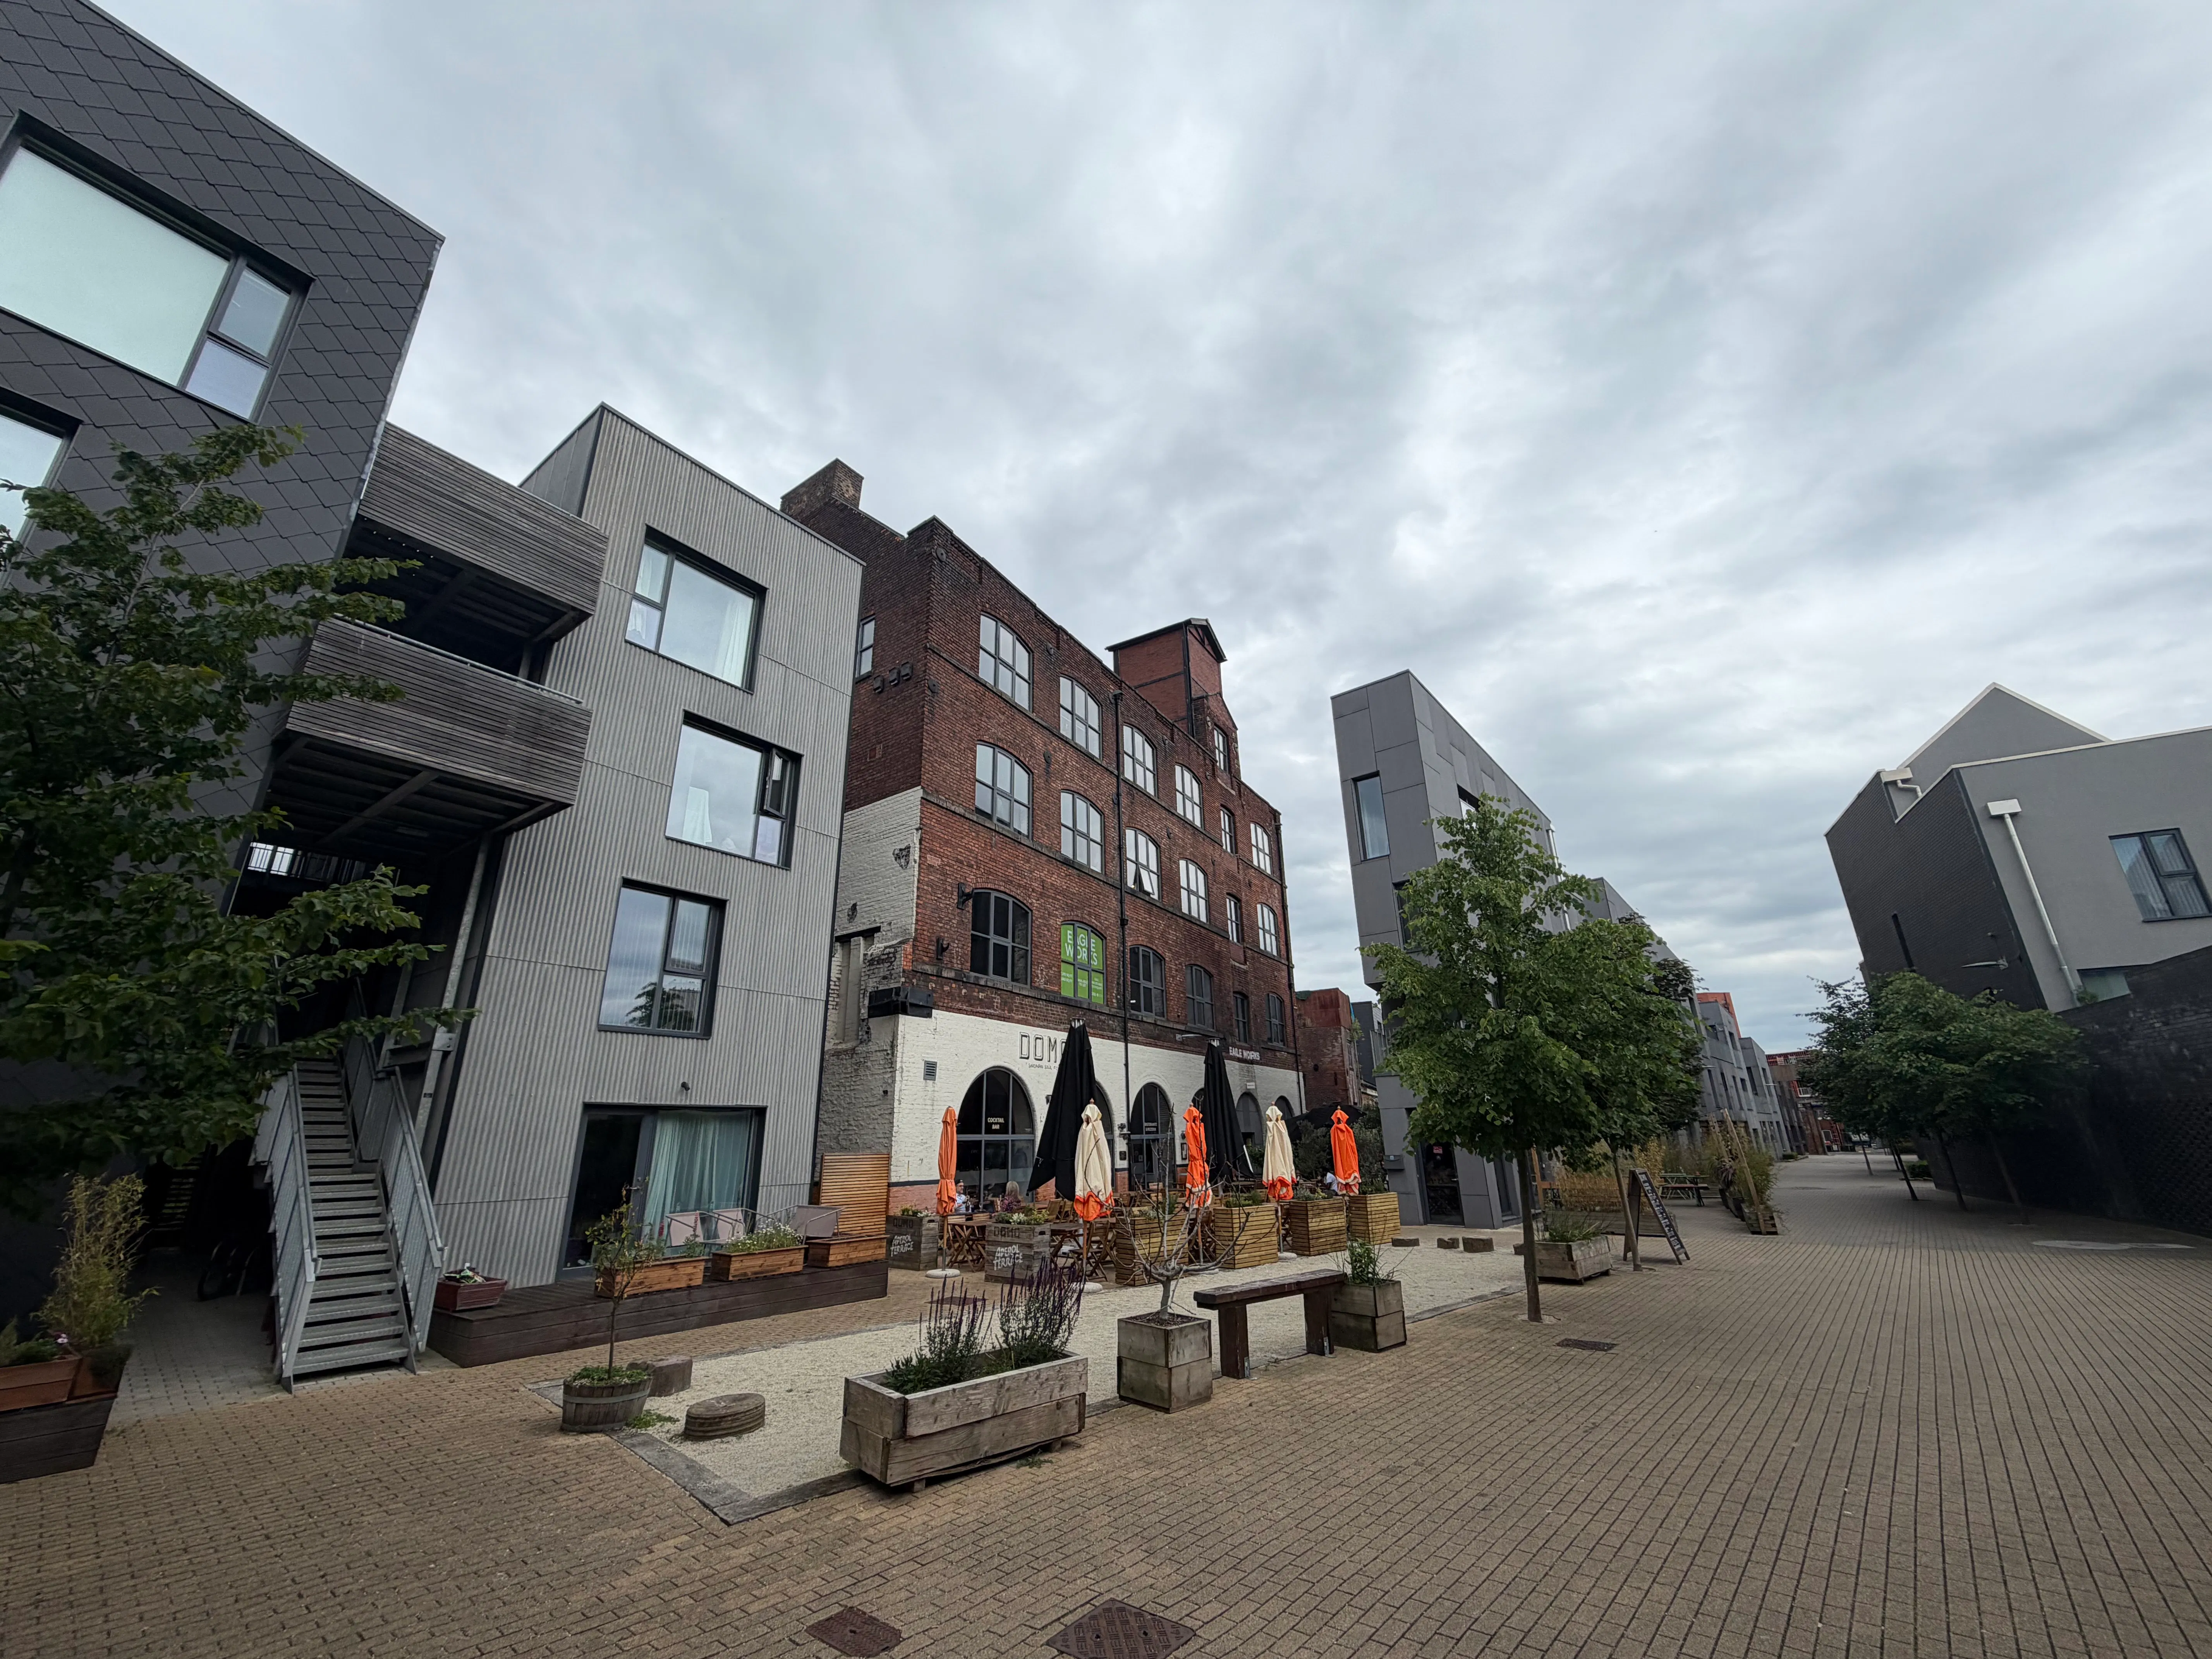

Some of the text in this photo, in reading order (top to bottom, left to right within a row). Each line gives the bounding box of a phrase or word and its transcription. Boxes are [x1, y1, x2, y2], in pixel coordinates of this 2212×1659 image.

[1065, 943, 1097, 965] WORS
[1229, 1046, 1260, 1060] EAGLE WORKS
[892, 1234, 912, 1247] APEROL
[890, 1242, 914, 1257] TERRACE
[994, 1243, 1020, 1260] APEROL
